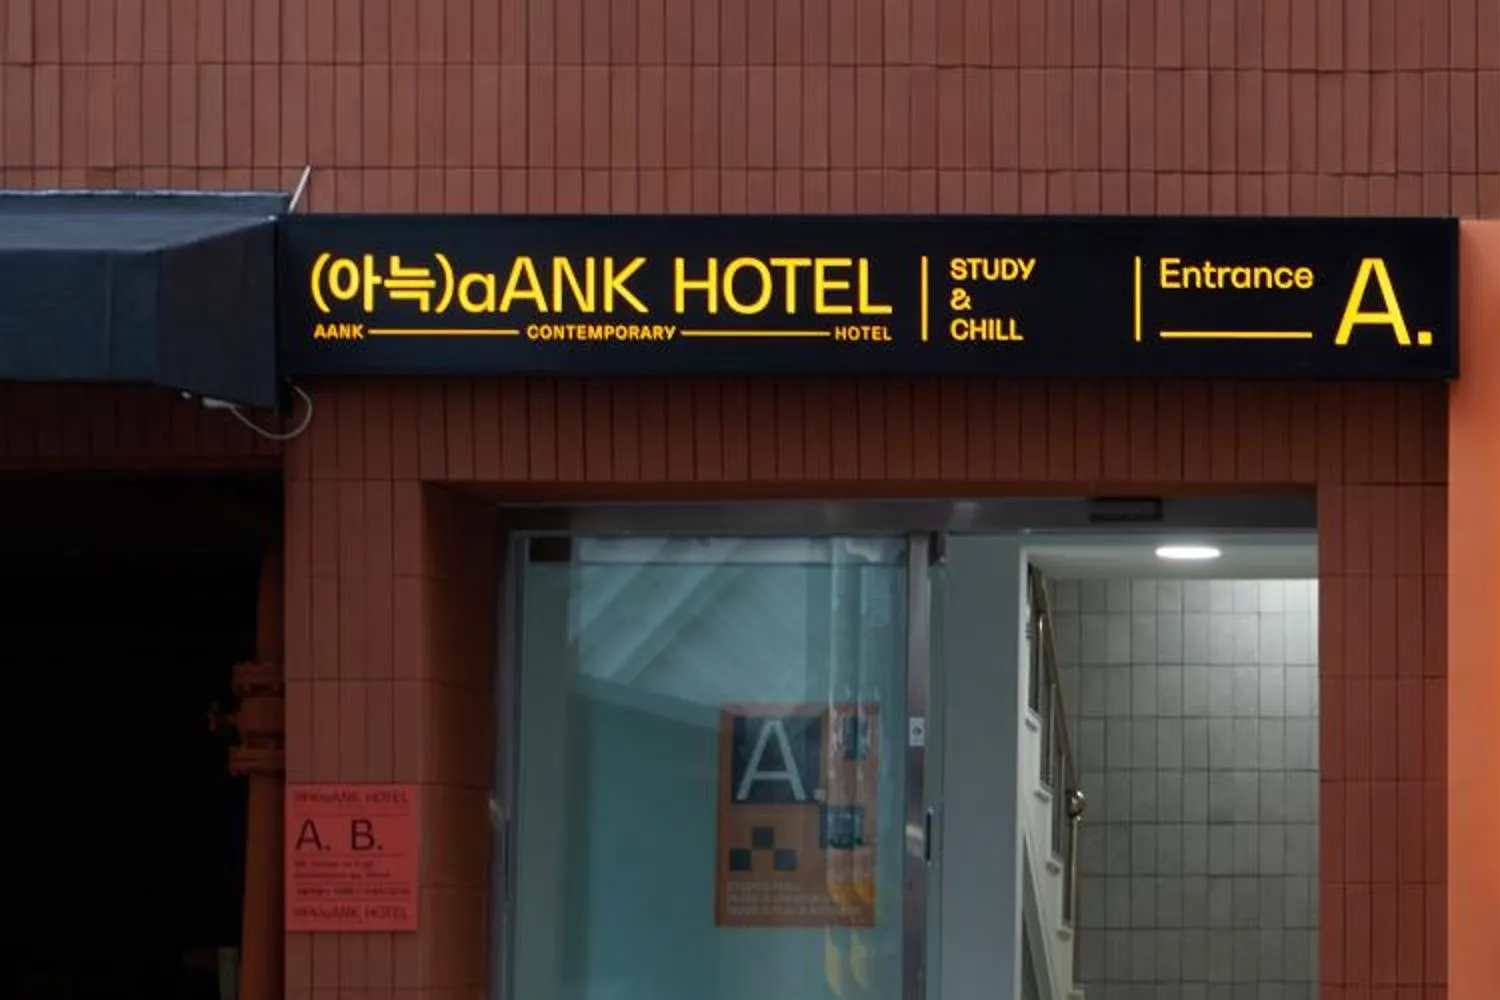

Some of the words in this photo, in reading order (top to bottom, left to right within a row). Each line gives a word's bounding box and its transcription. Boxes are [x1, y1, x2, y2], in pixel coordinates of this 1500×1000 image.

[949, 257, 1036, 281] STUDY
[1159, 257, 1314, 289] Entrance
[674, 256, 893, 315] HOTEL
[949, 287, 972, 311] &
[1334, 257, 1433, 346] A.
[313, 323, 364, 340] AANK
[526, 324, 677, 341] CONTEMPORARY
[834, 325, 893, 342] HOTEL
[949, 317, 1024, 341] CHILL
[735, 719, 827, 802] A.
[295, 819, 331, 852] A.
[350, 819, 382, 852] B.
